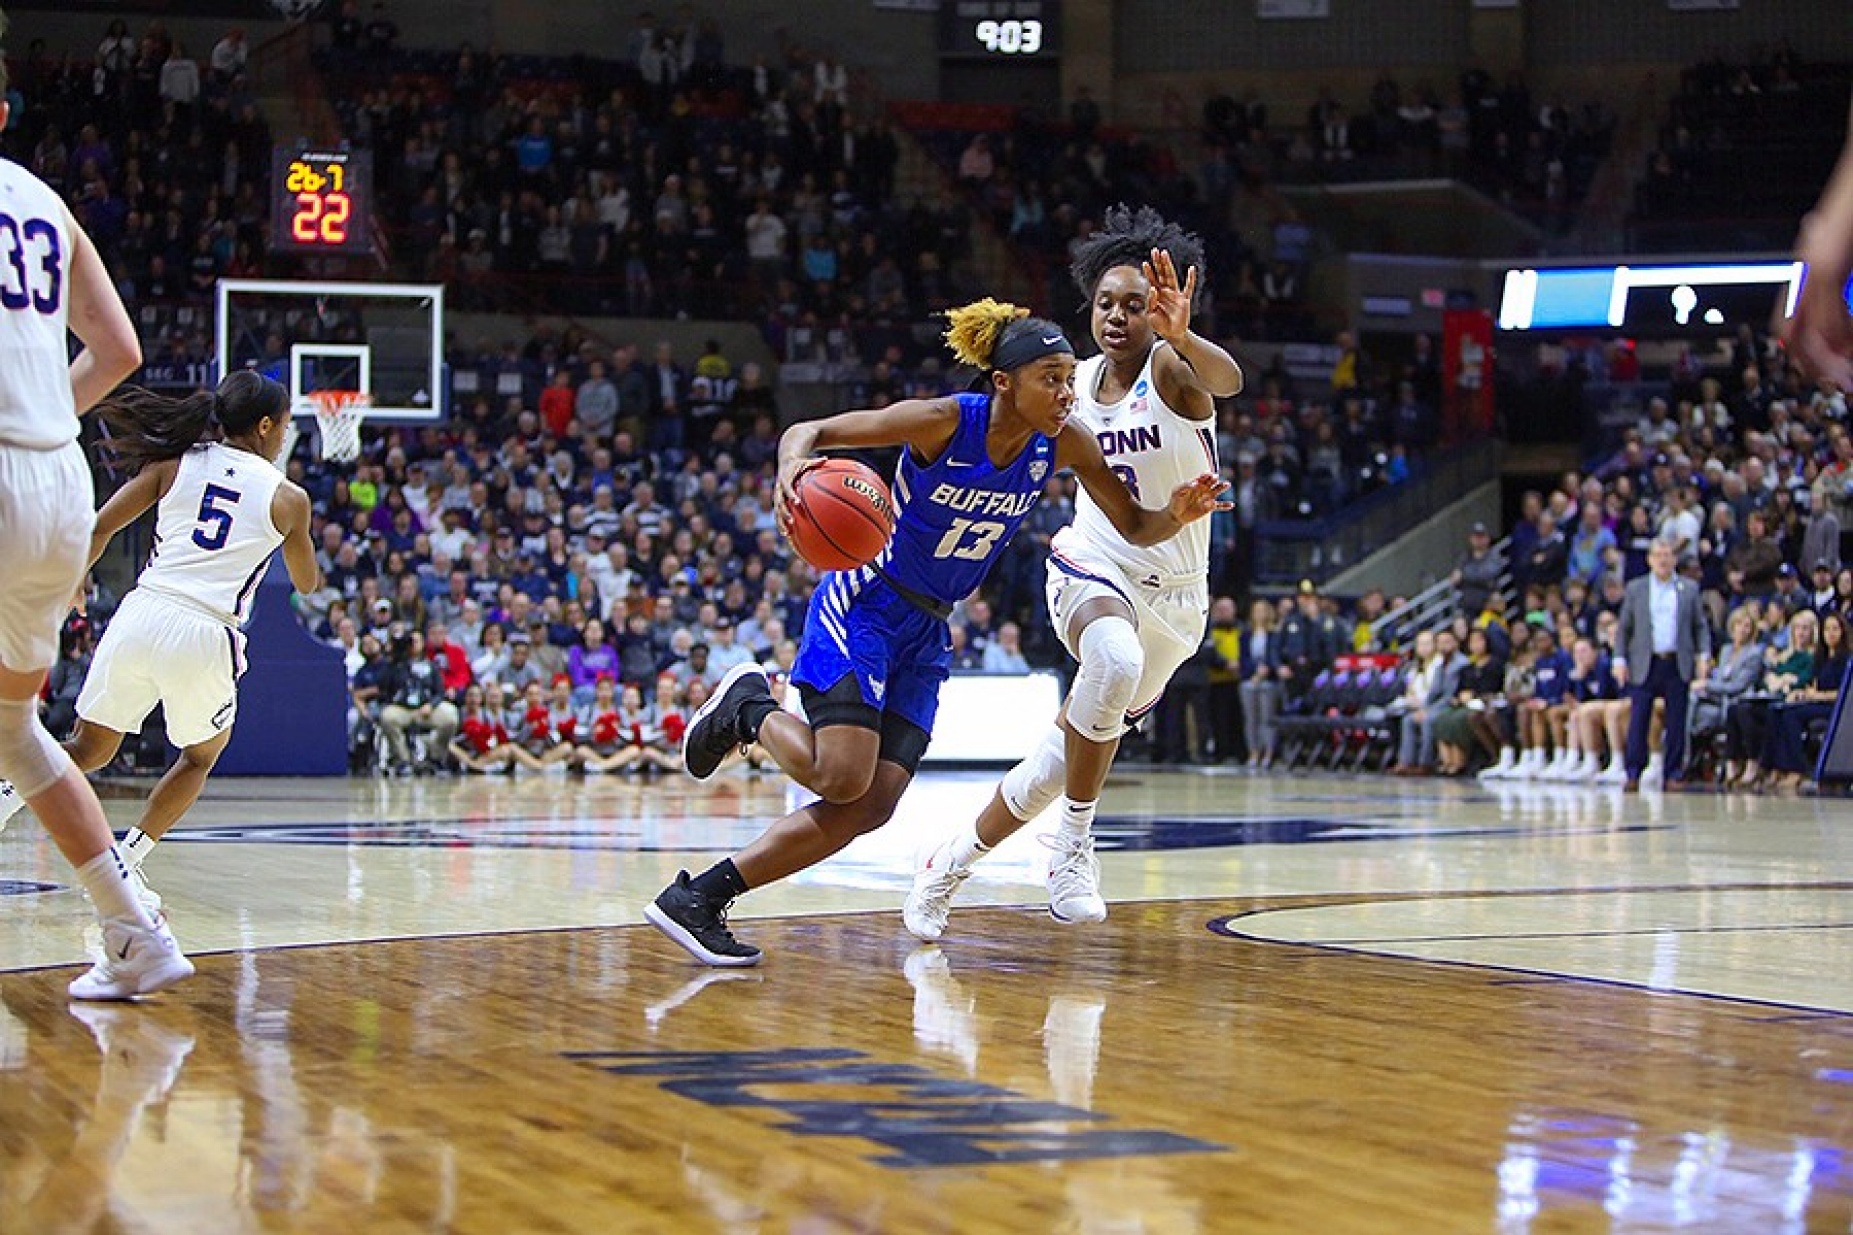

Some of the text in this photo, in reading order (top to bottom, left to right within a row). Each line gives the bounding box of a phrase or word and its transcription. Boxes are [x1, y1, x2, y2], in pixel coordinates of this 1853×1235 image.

[292, 192, 350, 243] 22
[0, 213, 62, 315] 33
[191, 482, 241, 551] 5
[929, 482, 1041, 516] BUFFALO
[934, 517, 1005, 559] 13
